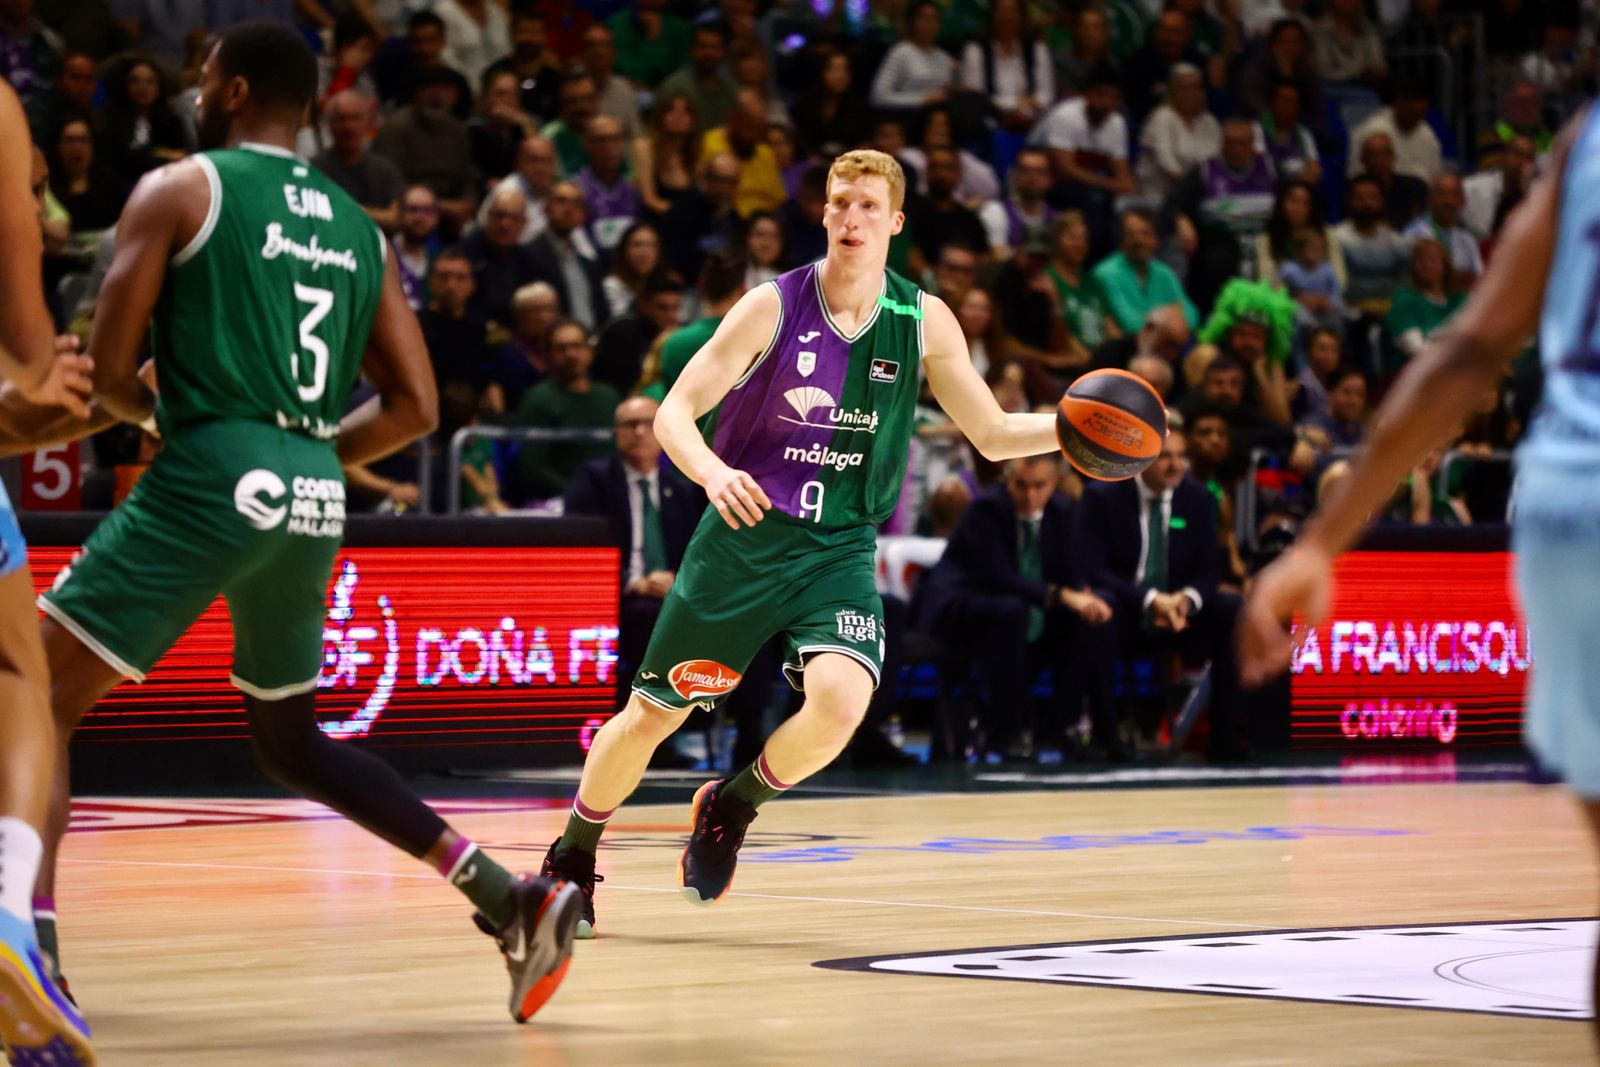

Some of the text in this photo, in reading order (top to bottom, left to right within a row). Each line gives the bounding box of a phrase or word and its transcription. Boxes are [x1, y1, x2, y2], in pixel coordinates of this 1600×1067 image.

[291, 281, 334, 403] 3
[32, 443, 72, 500] 5
[783, 443, 864, 472] málaga
[798, 480, 825, 523] 9
[415, 616, 556, 686] DOÑA
[1339, 696, 1457, 744] catering
